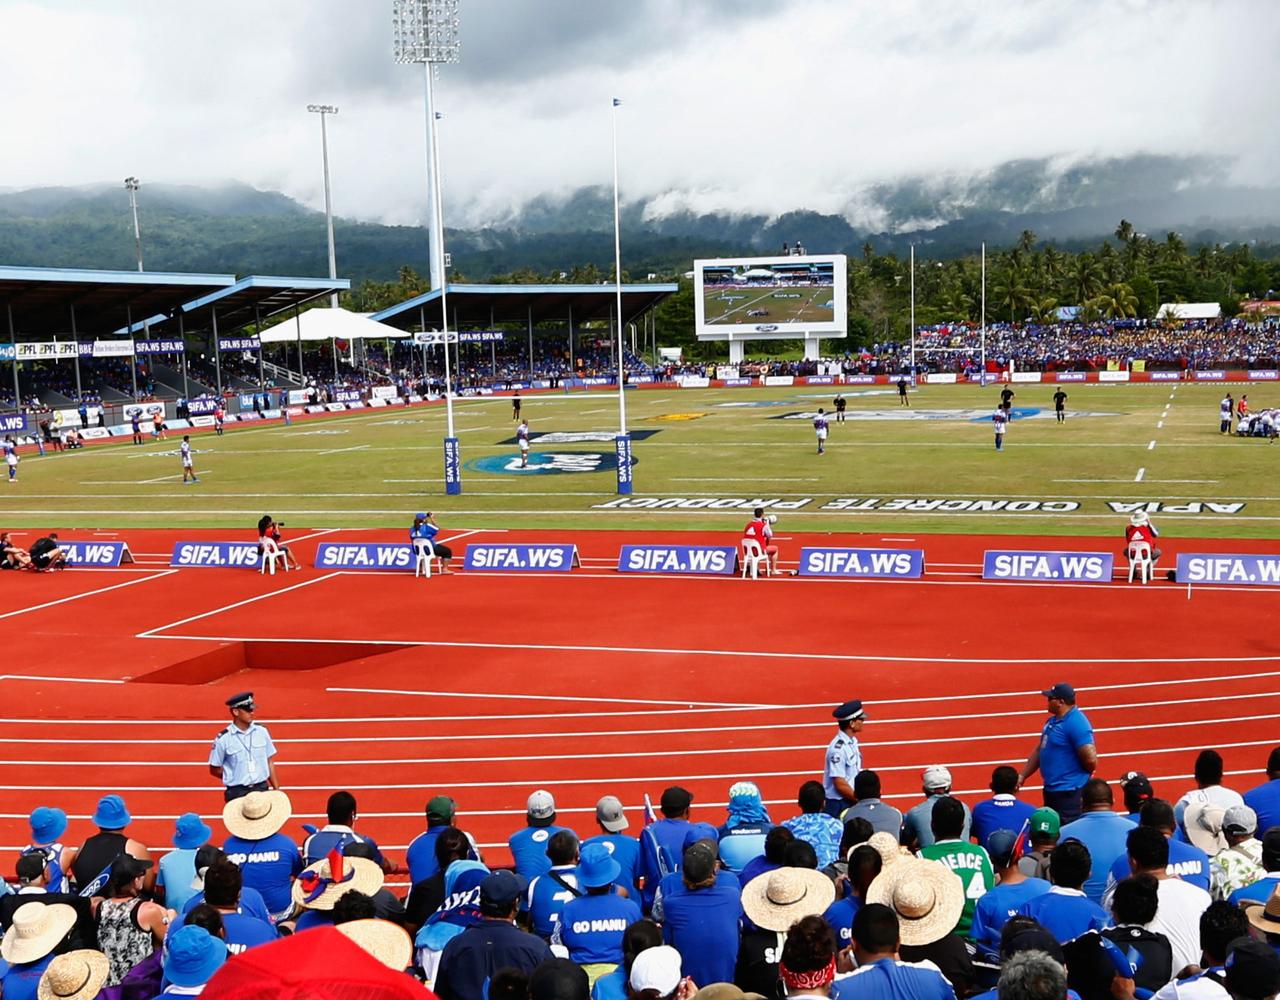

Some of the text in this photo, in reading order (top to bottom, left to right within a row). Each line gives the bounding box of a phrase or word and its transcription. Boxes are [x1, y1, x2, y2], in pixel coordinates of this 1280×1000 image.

[136, 343, 159, 352] SIFA.WS
[161, 342, 184, 351] SIFA.WS
[220, 339, 261, 349] SIFA.WS SIFA.WS
[820, 498, 1081, 512] CONCRETE
[178, 544, 259, 566] SIFA.WS
[323, 545, 411, 567] SIFA.WS
[471, 546, 564, 568] SIFA.WS
[628, 548, 727, 571] SIFA.WS
[807, 552, 912, 575] SIFA.WS
[994, 555, 1104, 579] SIFA.WS
[248, 850, 279, 863] MANU
[966, 872, 987, 899] 4
[573, 919, 627, 934] GO MANU
